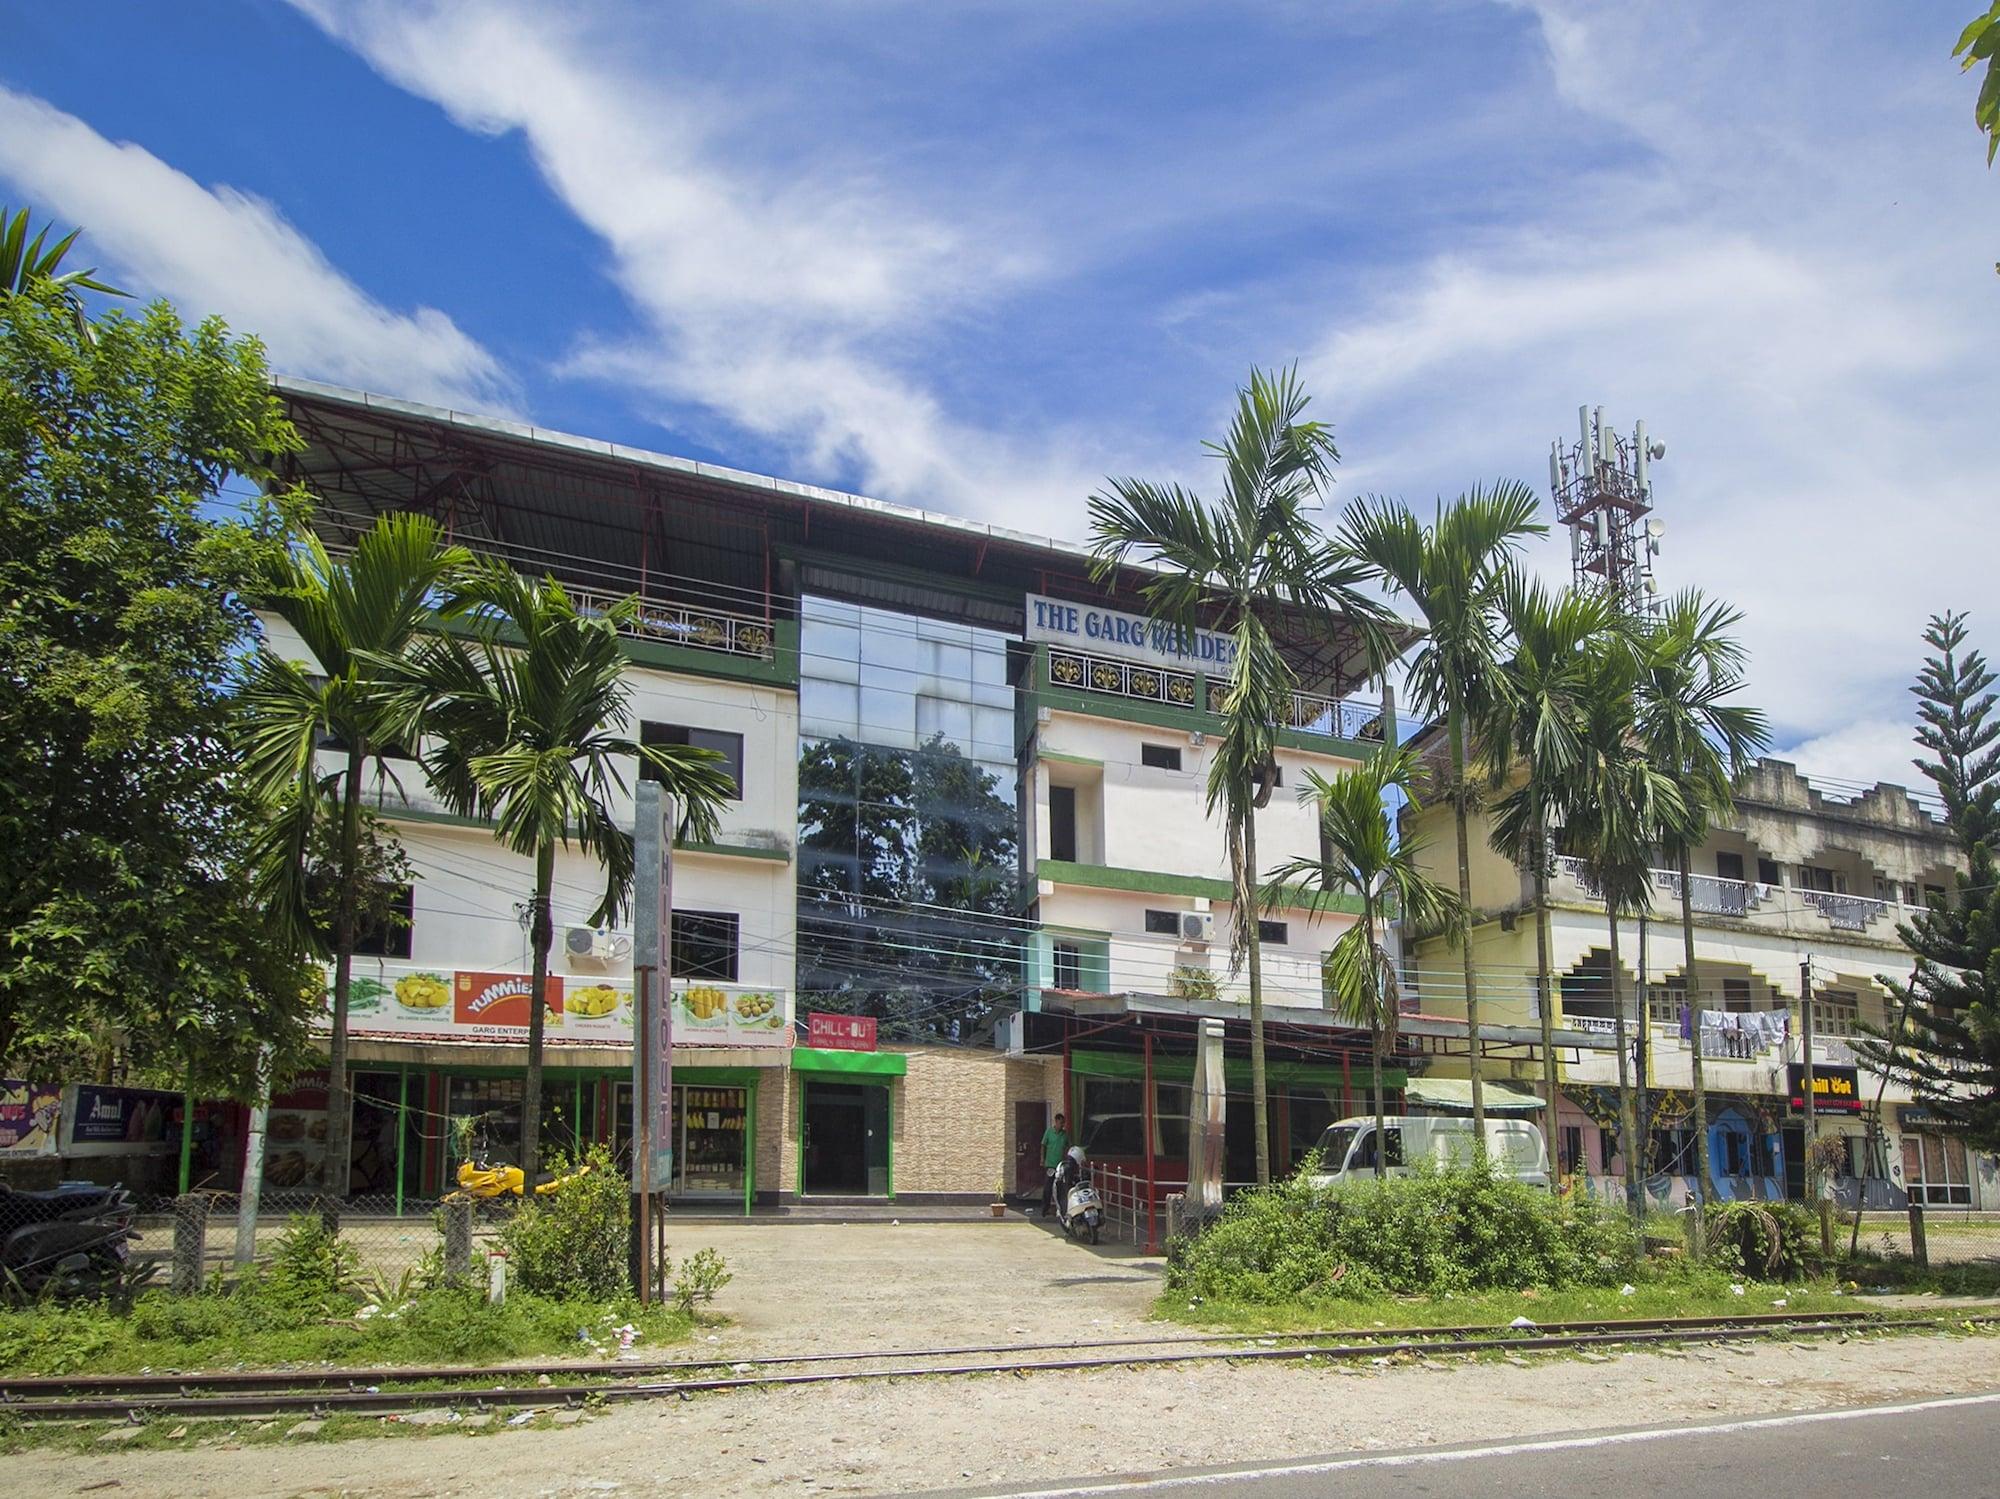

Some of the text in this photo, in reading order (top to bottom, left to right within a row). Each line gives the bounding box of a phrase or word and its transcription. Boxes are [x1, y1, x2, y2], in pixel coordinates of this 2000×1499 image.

[1034, 600, 1078, 635] THE
[1085, 611, 1144, 648] GARG
[472, 1026, 496, 1034] GARG
[88, 1095, 123, 1121] Amul
